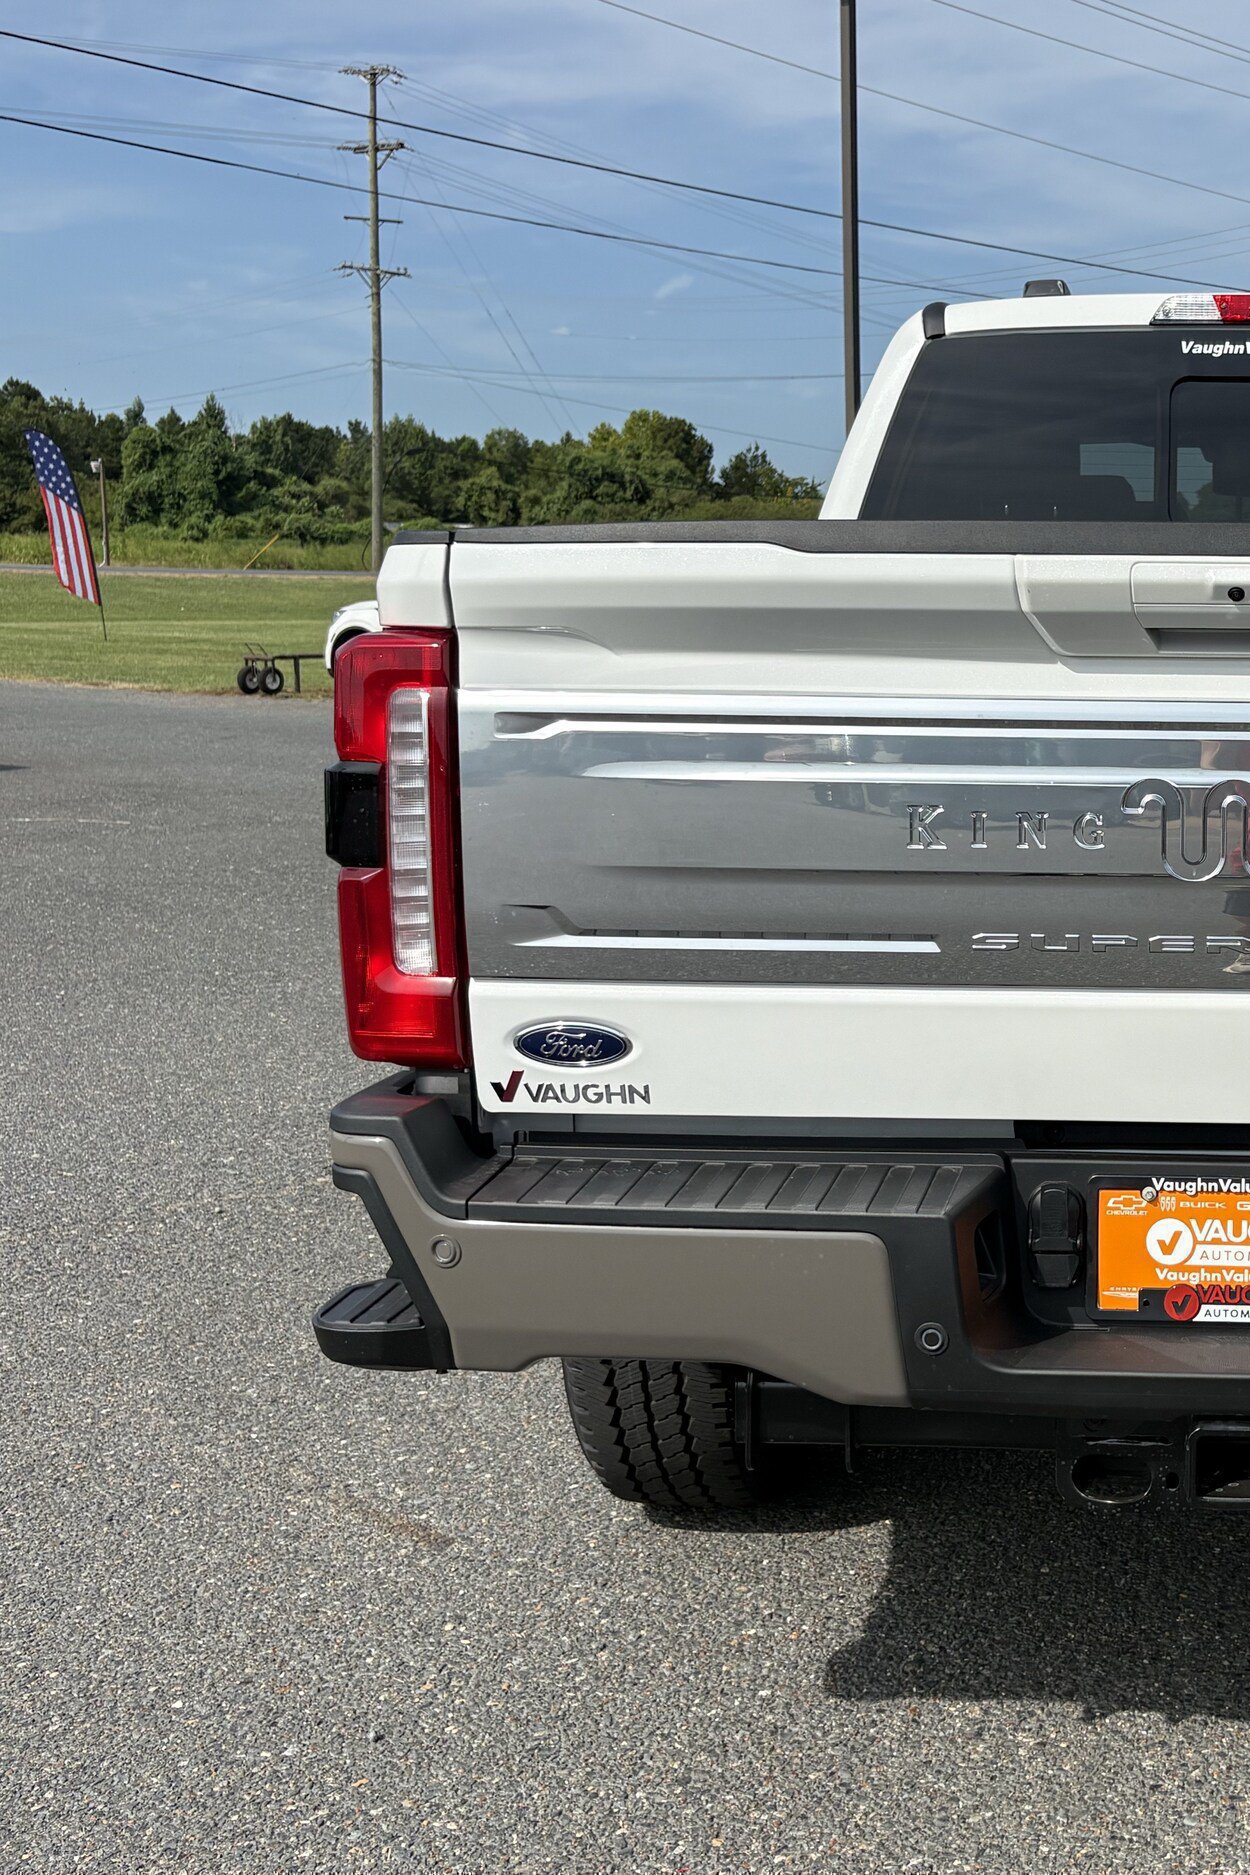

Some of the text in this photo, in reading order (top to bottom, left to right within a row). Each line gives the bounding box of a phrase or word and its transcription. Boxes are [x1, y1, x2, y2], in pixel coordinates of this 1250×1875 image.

[906, 804, 1105, 850] KING
[540, 1031, 603, 1058] Ford
[523, 1082, 651, 1105] VAUGHN
[1179, 1201, 1227, 1209] BUICK
